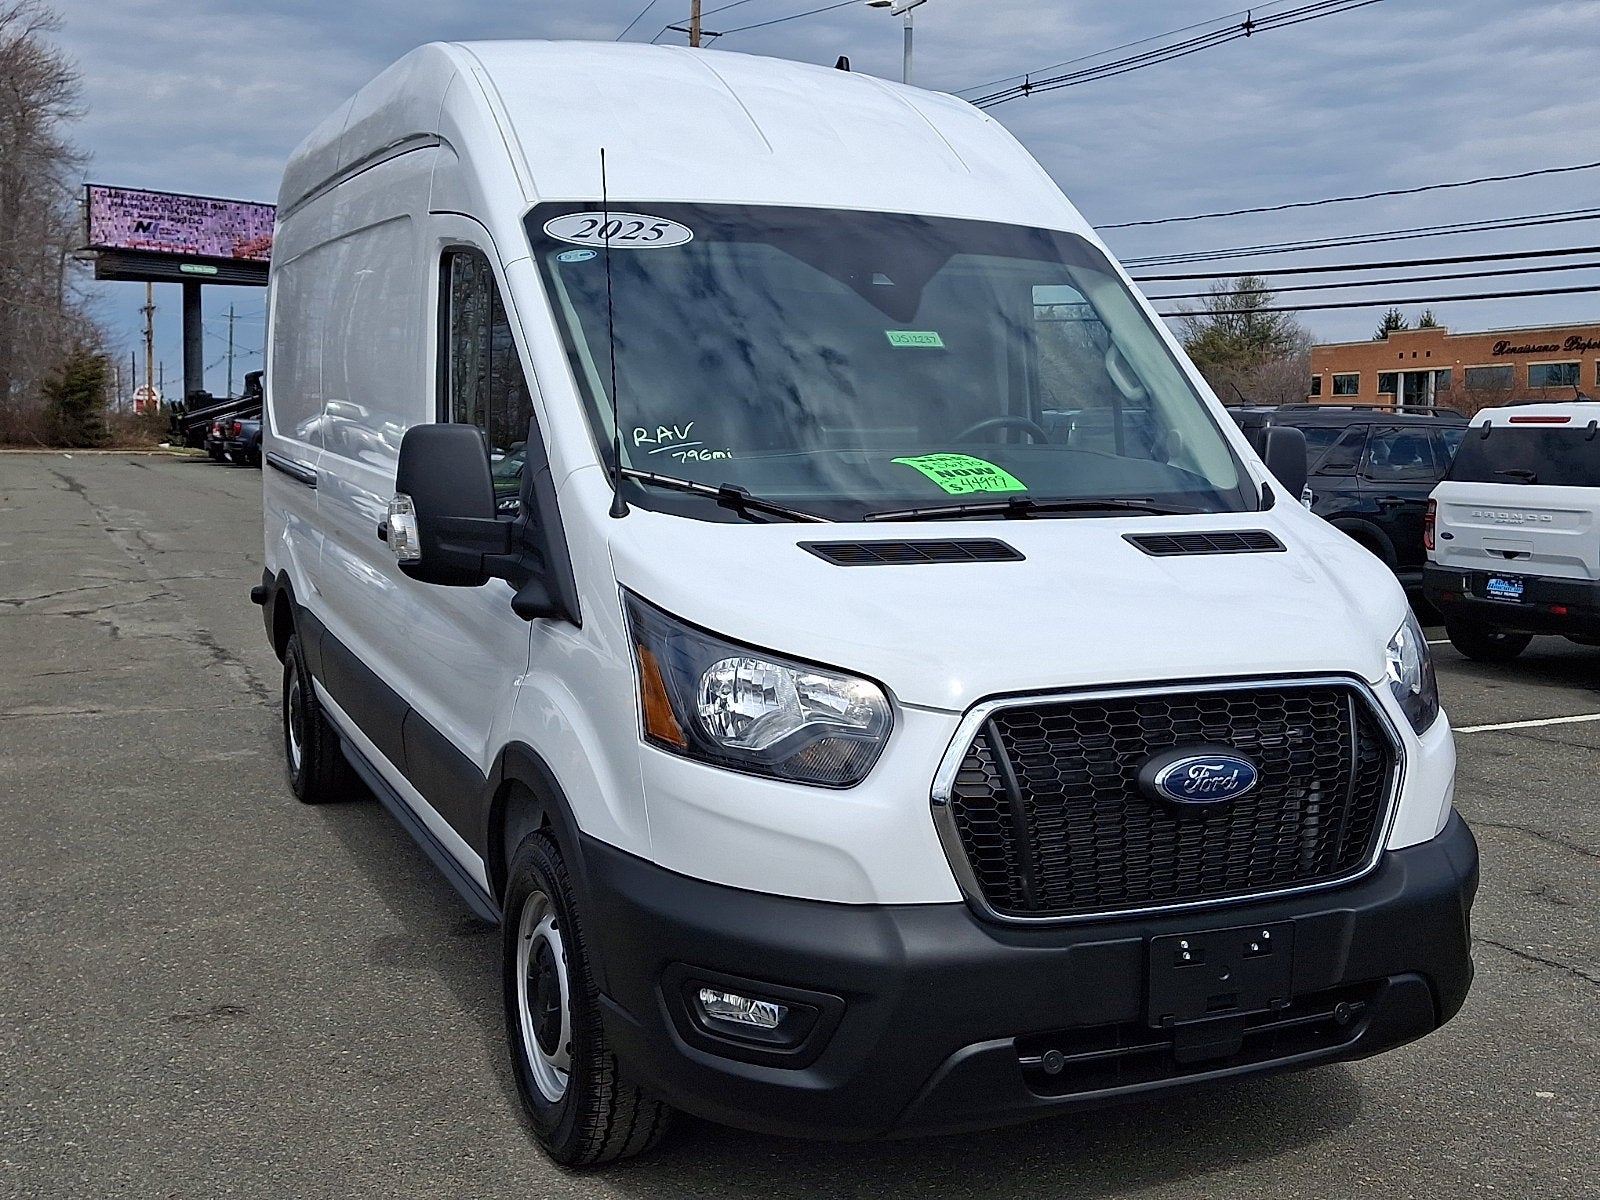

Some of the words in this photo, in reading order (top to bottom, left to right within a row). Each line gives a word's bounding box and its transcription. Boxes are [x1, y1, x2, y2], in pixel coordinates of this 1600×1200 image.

[175, 199, 208, 209] COUNT
[570, 218, 669, 241] 2025
[1492, 340, 1560, 356] Renaissance
[633, 421, 694, 447] RAV
[672, 447, 732, 464] 796mi
[934, 467, 996, 478] NOW
[1471, 510, 1553, 523] BRONCO
[1183, 764, 1239, 794] Ford
